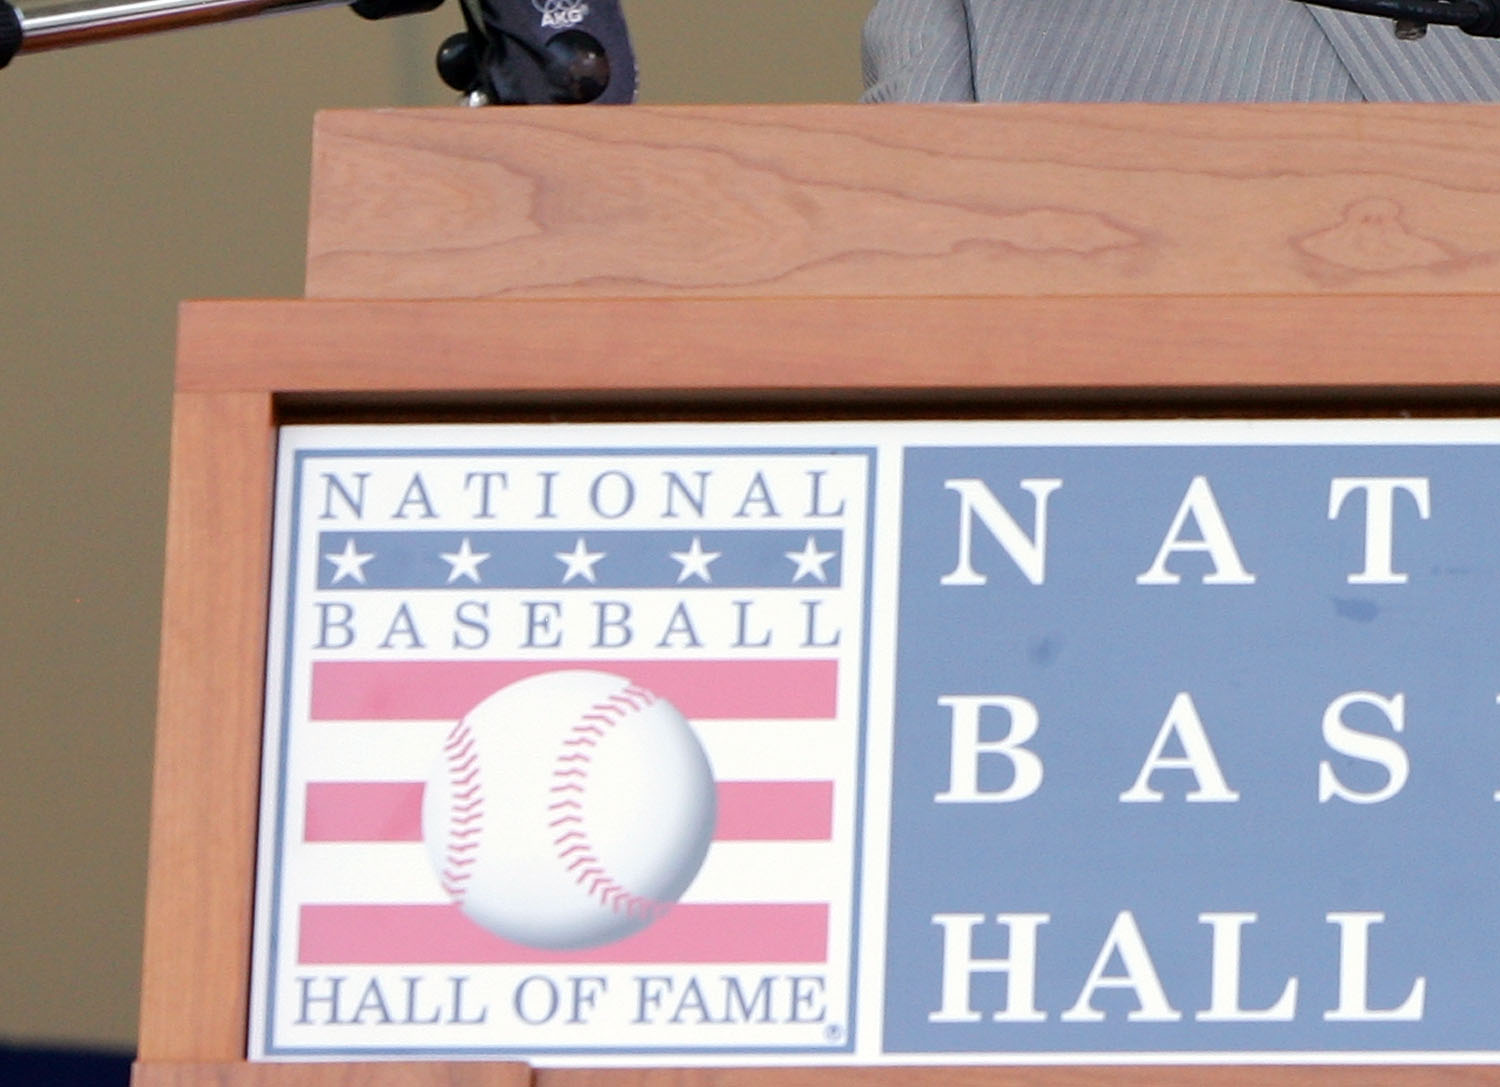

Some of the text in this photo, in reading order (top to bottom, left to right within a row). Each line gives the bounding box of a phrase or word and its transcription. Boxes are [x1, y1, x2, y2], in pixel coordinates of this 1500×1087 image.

[541, 9, 584, 27] AKG
[320, 471, 844, 519] NATIONAL
[314, 601, 840, 649] BASEBALL
[929, 911, 1425, 1022] HALL
[295, 976, 825, 1024] HALL OF FAME
